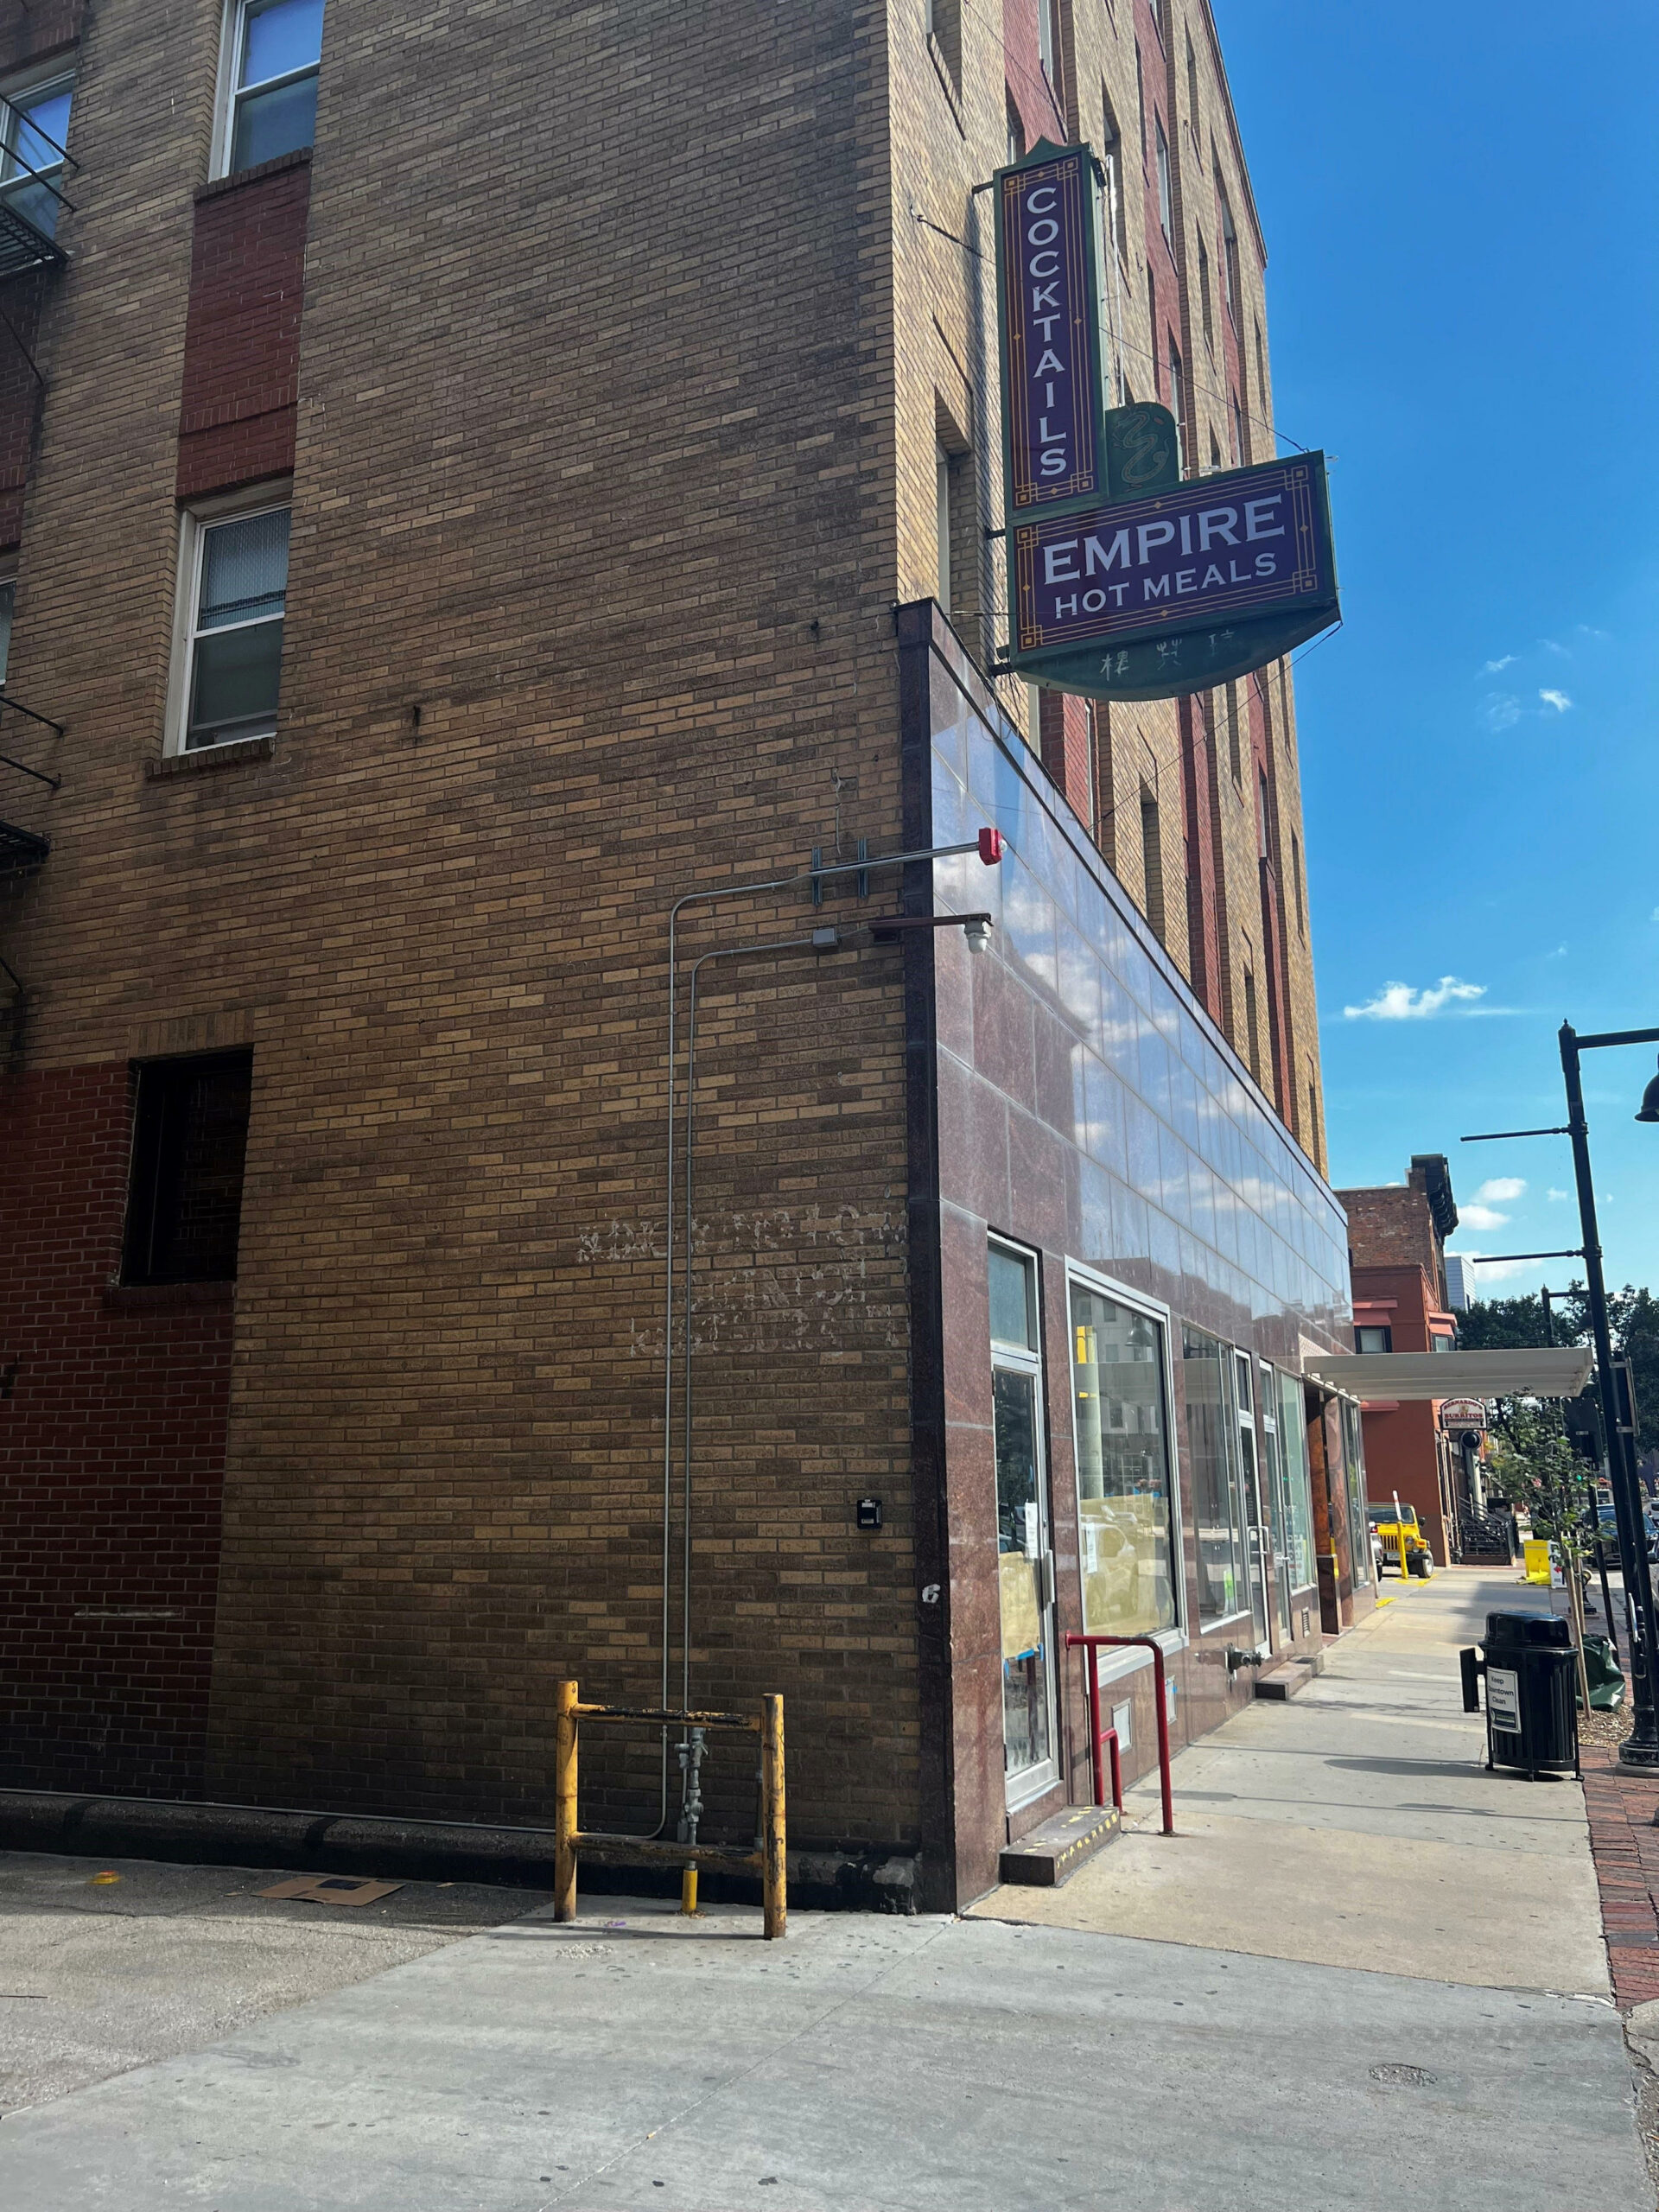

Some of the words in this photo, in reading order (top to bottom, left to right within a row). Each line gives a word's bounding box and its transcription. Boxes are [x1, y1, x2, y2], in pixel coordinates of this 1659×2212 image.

[1027, 187, 1067, 476] COCKTAILS
[1042, 493, 1285, 585] EMPIRE
[1055, 582, 1129, 620] HOT
[1142, 552, 1277, 601] MEALS
[1491, 1676, 1504, 1685] Keep
[1492, 1696, 1506, 1705] Clean
